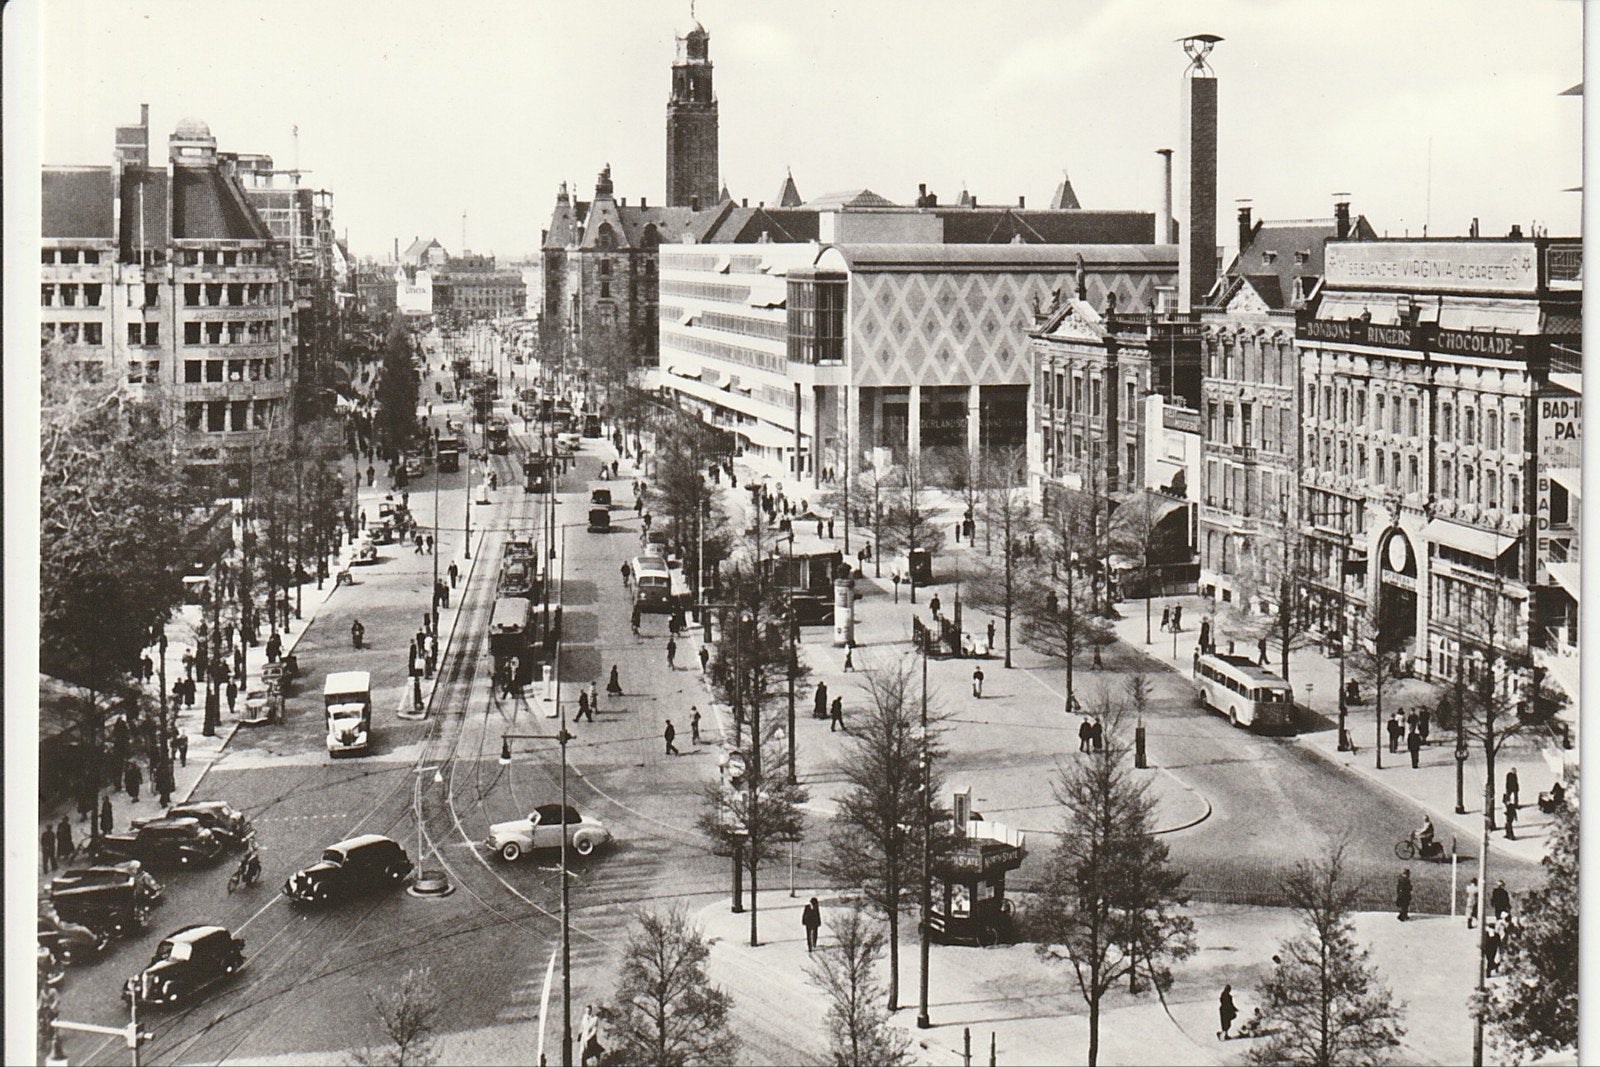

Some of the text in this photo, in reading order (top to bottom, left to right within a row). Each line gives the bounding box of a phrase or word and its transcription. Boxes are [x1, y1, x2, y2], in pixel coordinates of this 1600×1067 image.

[1459, 258, 1517, 280] CIGARETTES
[1307, 322, 1513, 355] BONBONS RINGERS CHOCOLADE
[1542, 401, 1581, 419] BAD-I
[1554, 421, 1581, 440] PA
